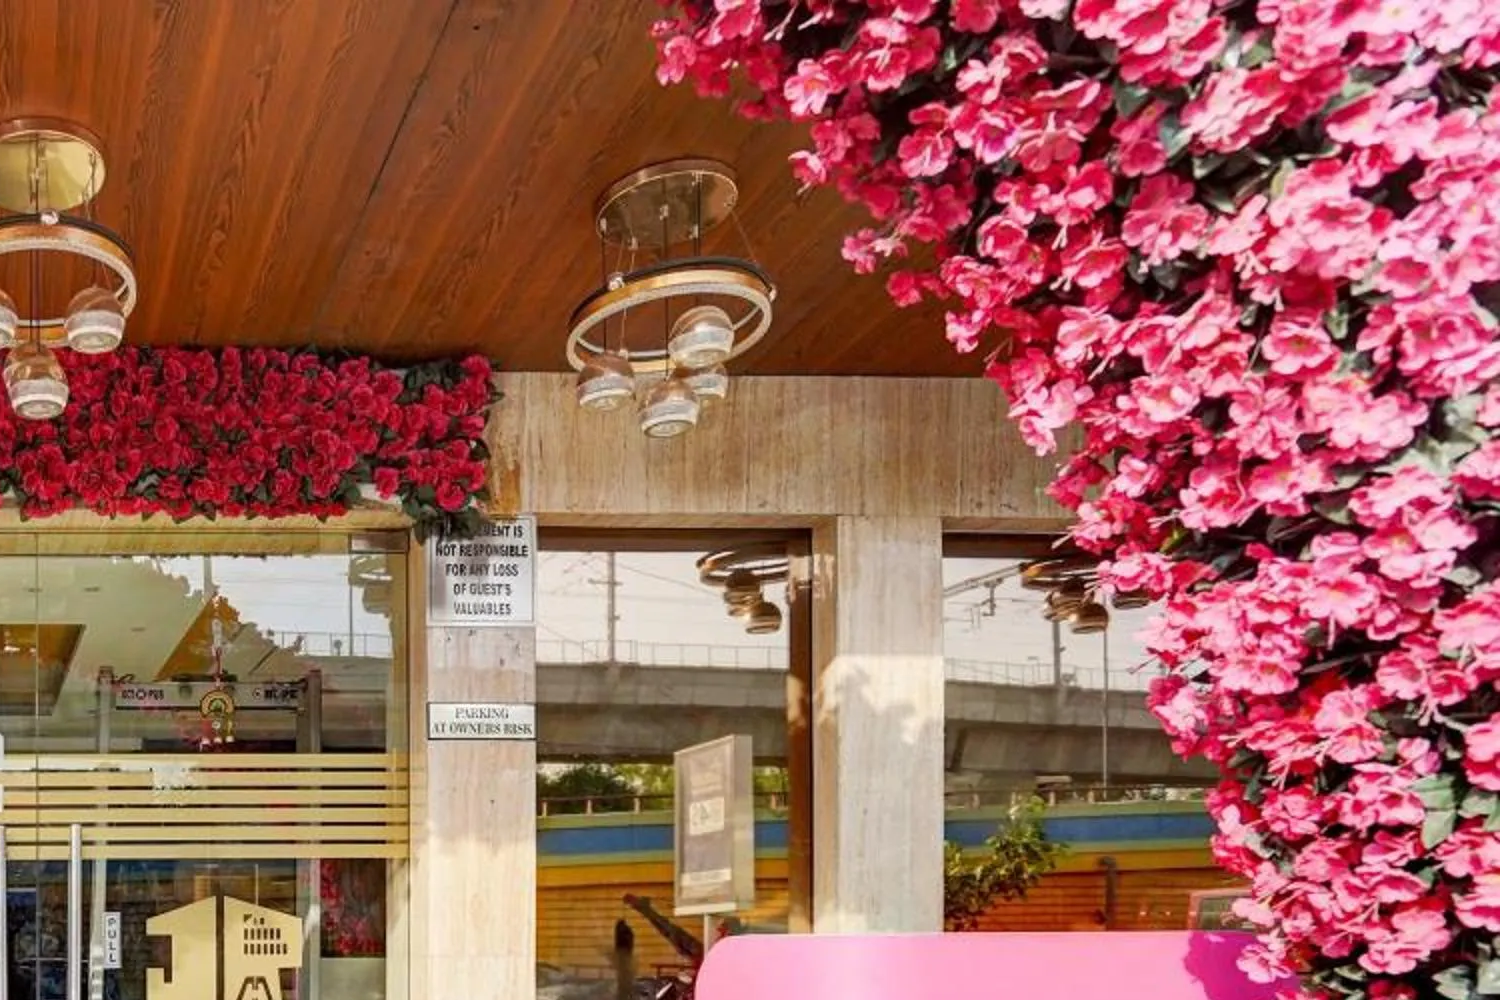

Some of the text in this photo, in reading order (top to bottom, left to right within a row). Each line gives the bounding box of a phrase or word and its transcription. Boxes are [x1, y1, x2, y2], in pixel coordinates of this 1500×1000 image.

[513, 525, 523, 538] IS
[436, 544, 528, 557] NOT RESPONSIBLE
[446, 563, 519, 577] FOR ANY LOSS
[453, 583, 467, 596] OF
[454, 602, 511, 615] VALUABLES
[455, 707, 509, 719] PARKING
[433, 722, 533, 735] AT OWNERS RISK
[107, 917, 117, 963] PULL
